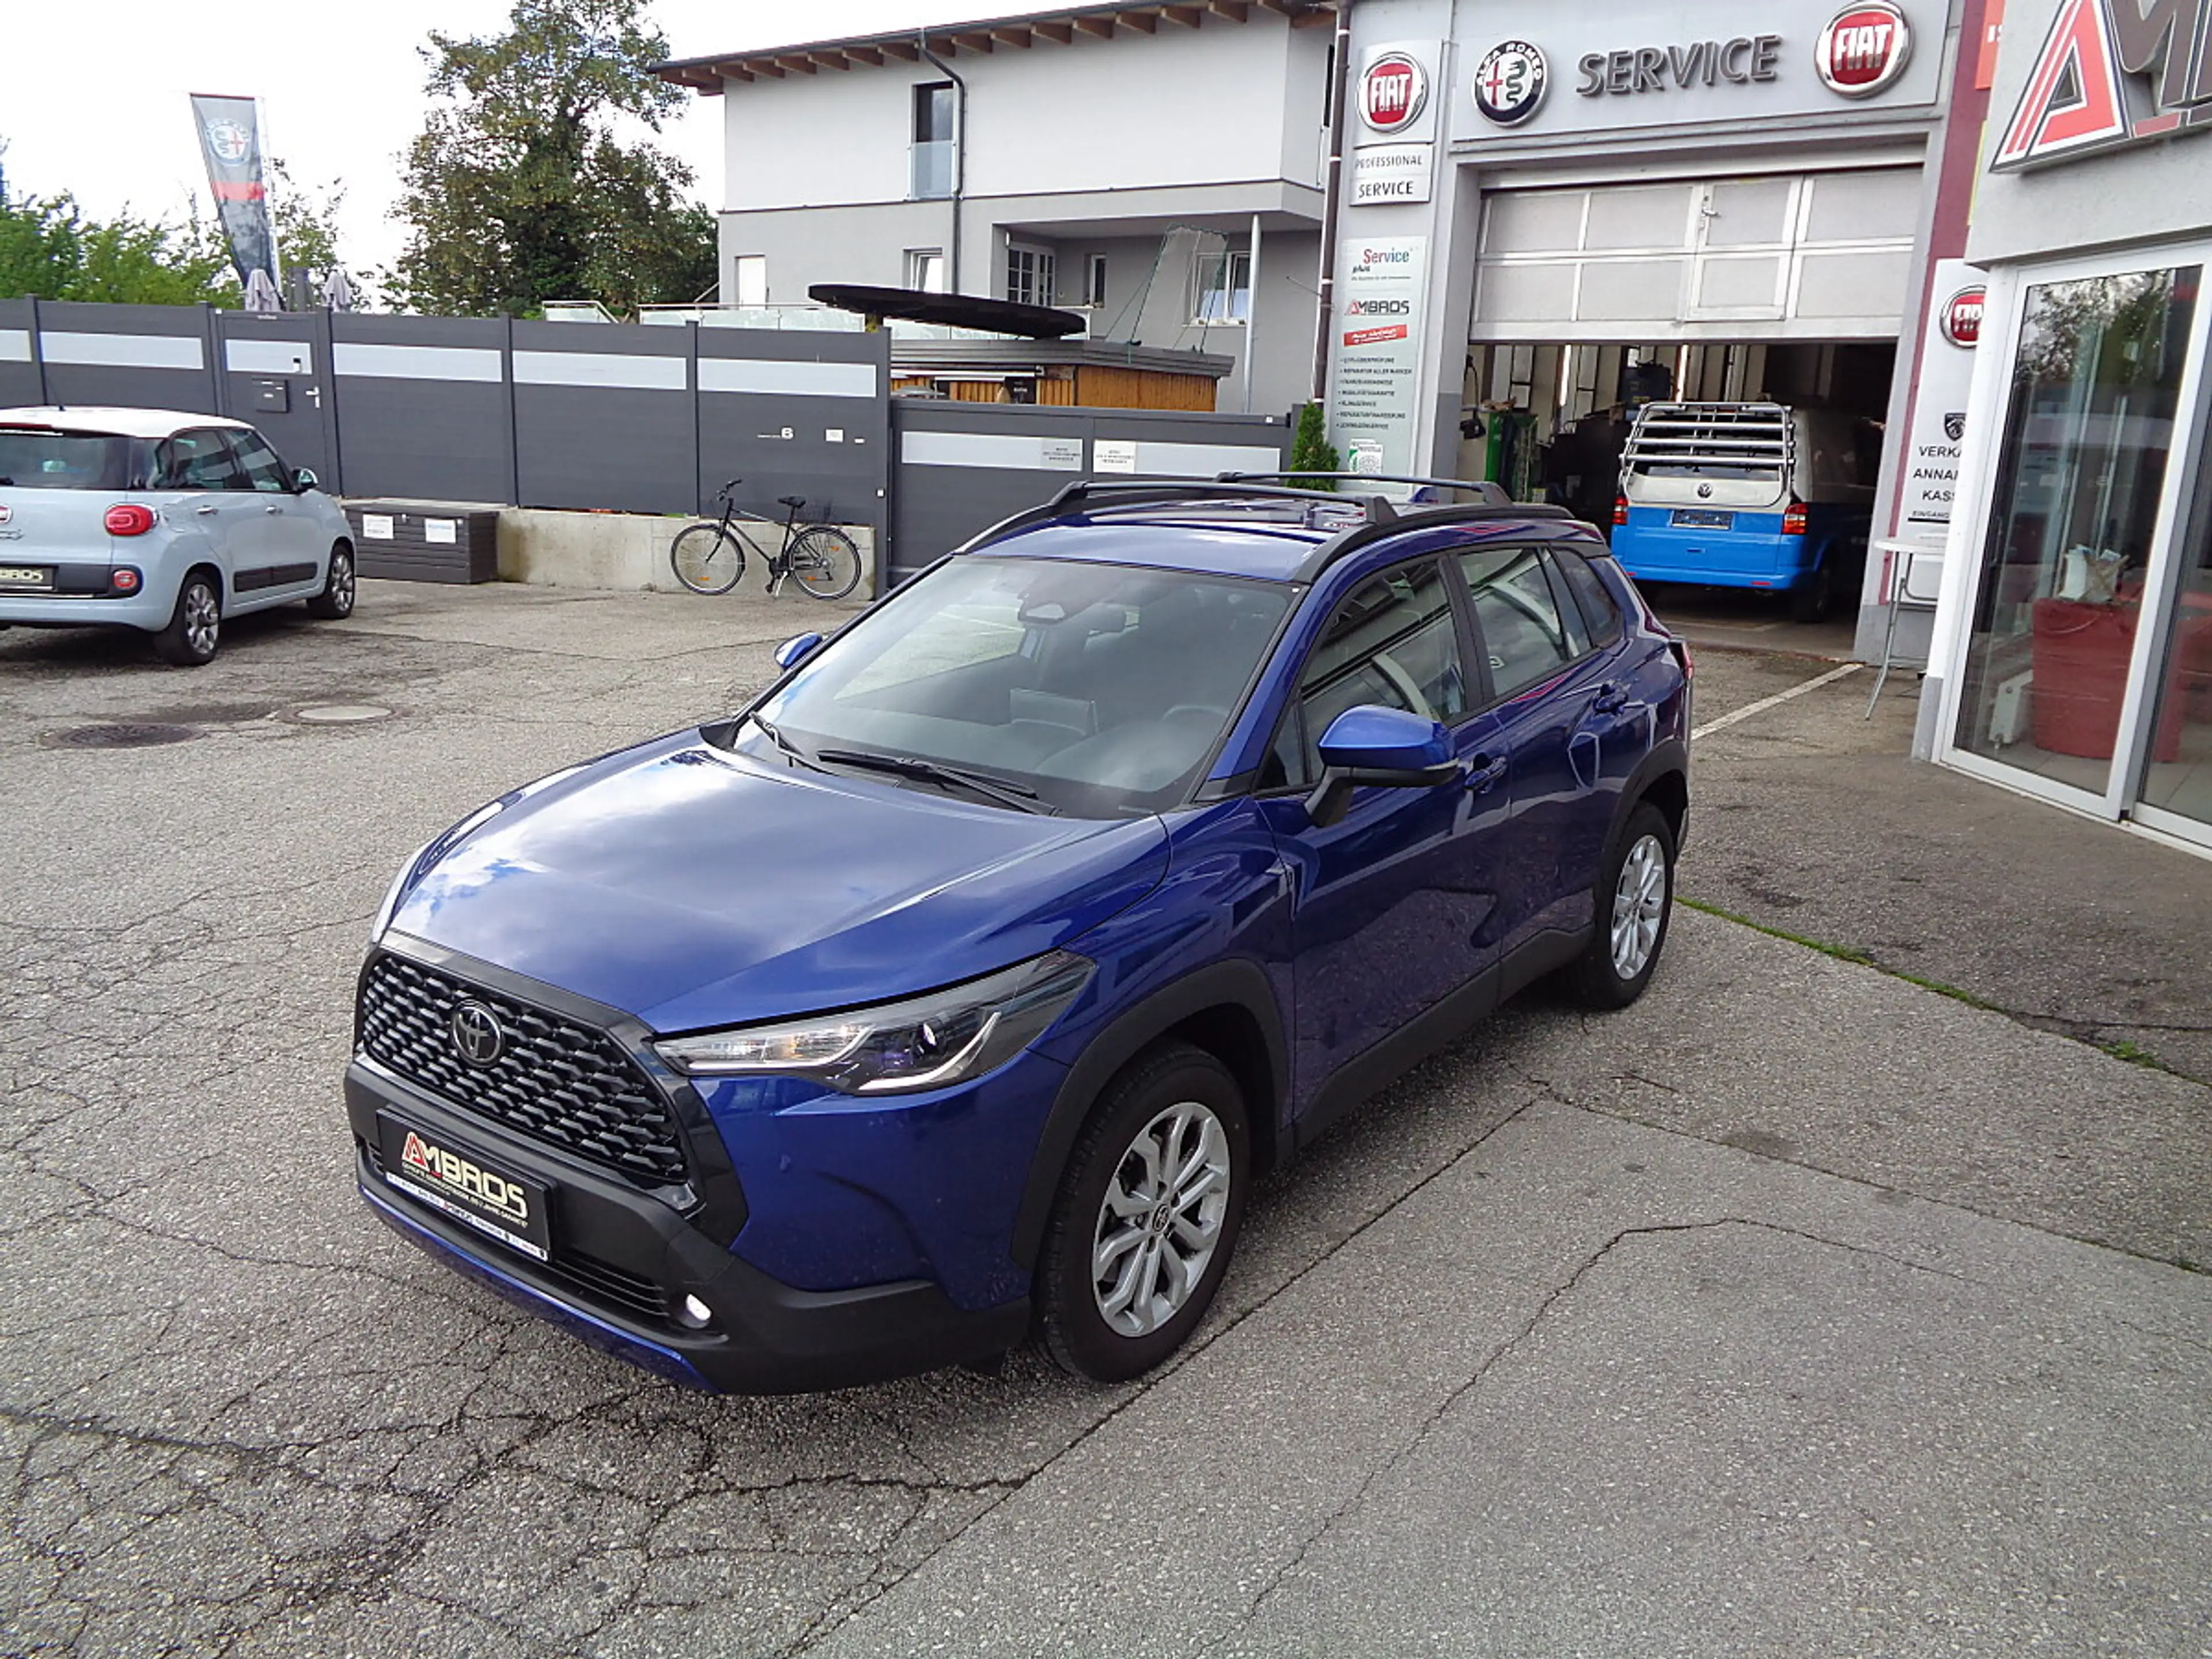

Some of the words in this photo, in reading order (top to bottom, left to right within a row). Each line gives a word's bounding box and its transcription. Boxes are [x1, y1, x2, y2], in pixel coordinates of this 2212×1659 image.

[1476, 50, 1501, 85] ALFA
[1506, 44, 1541, 79] ROMEO
[1577, 35, 1782, 97] SERVICE
[1835, 24, 1892, 70] FIAT
[1370, 74, 1411, 113] FIAT
[1990, 0, 2212, 172] AM
[1355, 155, 1422, 170] PROFESSIONAL
[1359, 180, 1414, 198] SERVICE
[1363, 248, 1410, 264] Service
[1346, 300, 1410, 315] AMBROS
[402, 1131, 528, 1218] AMBROS
